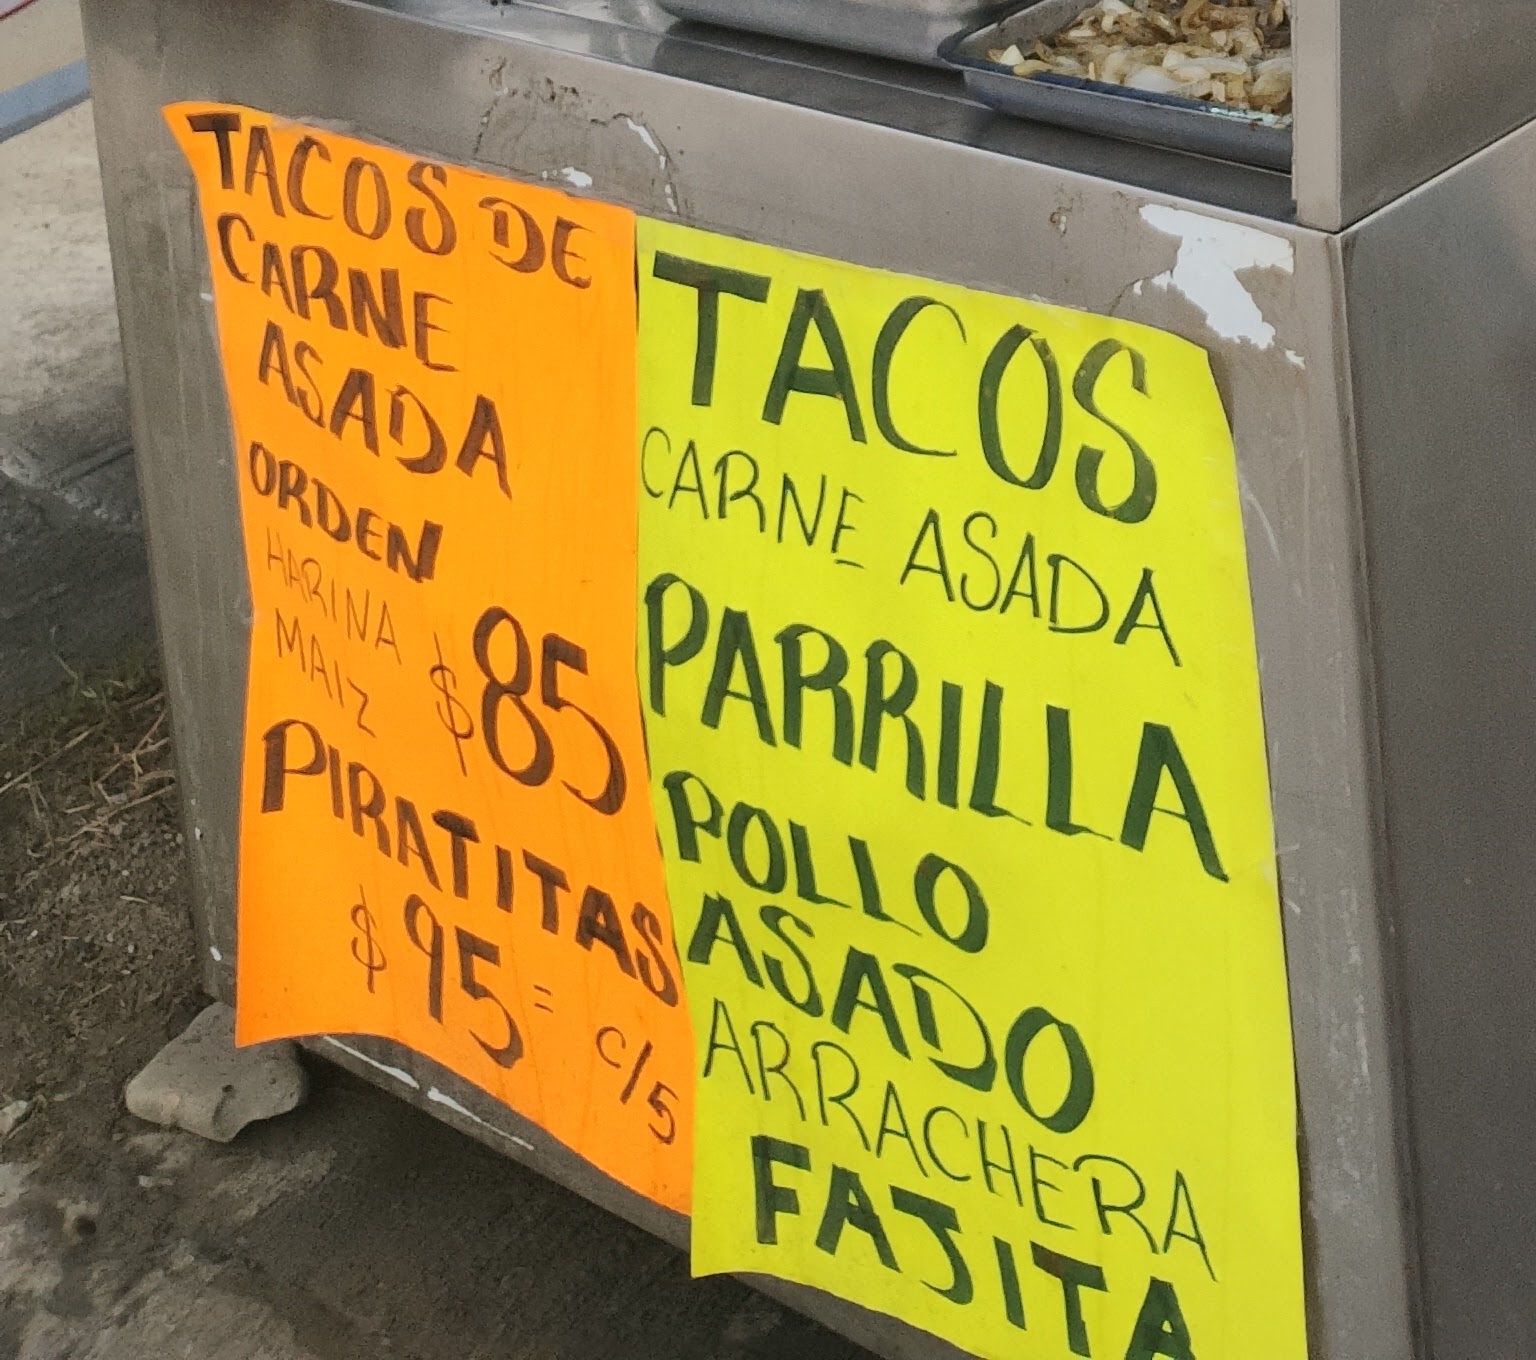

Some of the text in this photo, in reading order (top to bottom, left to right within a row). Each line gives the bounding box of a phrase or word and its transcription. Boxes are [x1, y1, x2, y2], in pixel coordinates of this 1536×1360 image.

[189, 111, 593, 288] TACOS DE
[217, 213, 461, 373] CARNE
[256, 320, 513, 500] ASADA
[651, 250, 1159, 527] TACOS
[248, 441, 443, 583] ORDEN
[266, 537, 402, 665] HARINA
[640, 424, 1183, 668] CARNE ASADA
[644, 571, 1230, 883] PARRILLA
[260, 717, 681, 1009] PIRATITAS
[662, 770, 990, 954] POLLO
[687, 891, 1096, 1135] ASADO
[701, 997, 1218, 1282] ARRACHERA
[750, 1132, 1200, 1360] FAJITA
